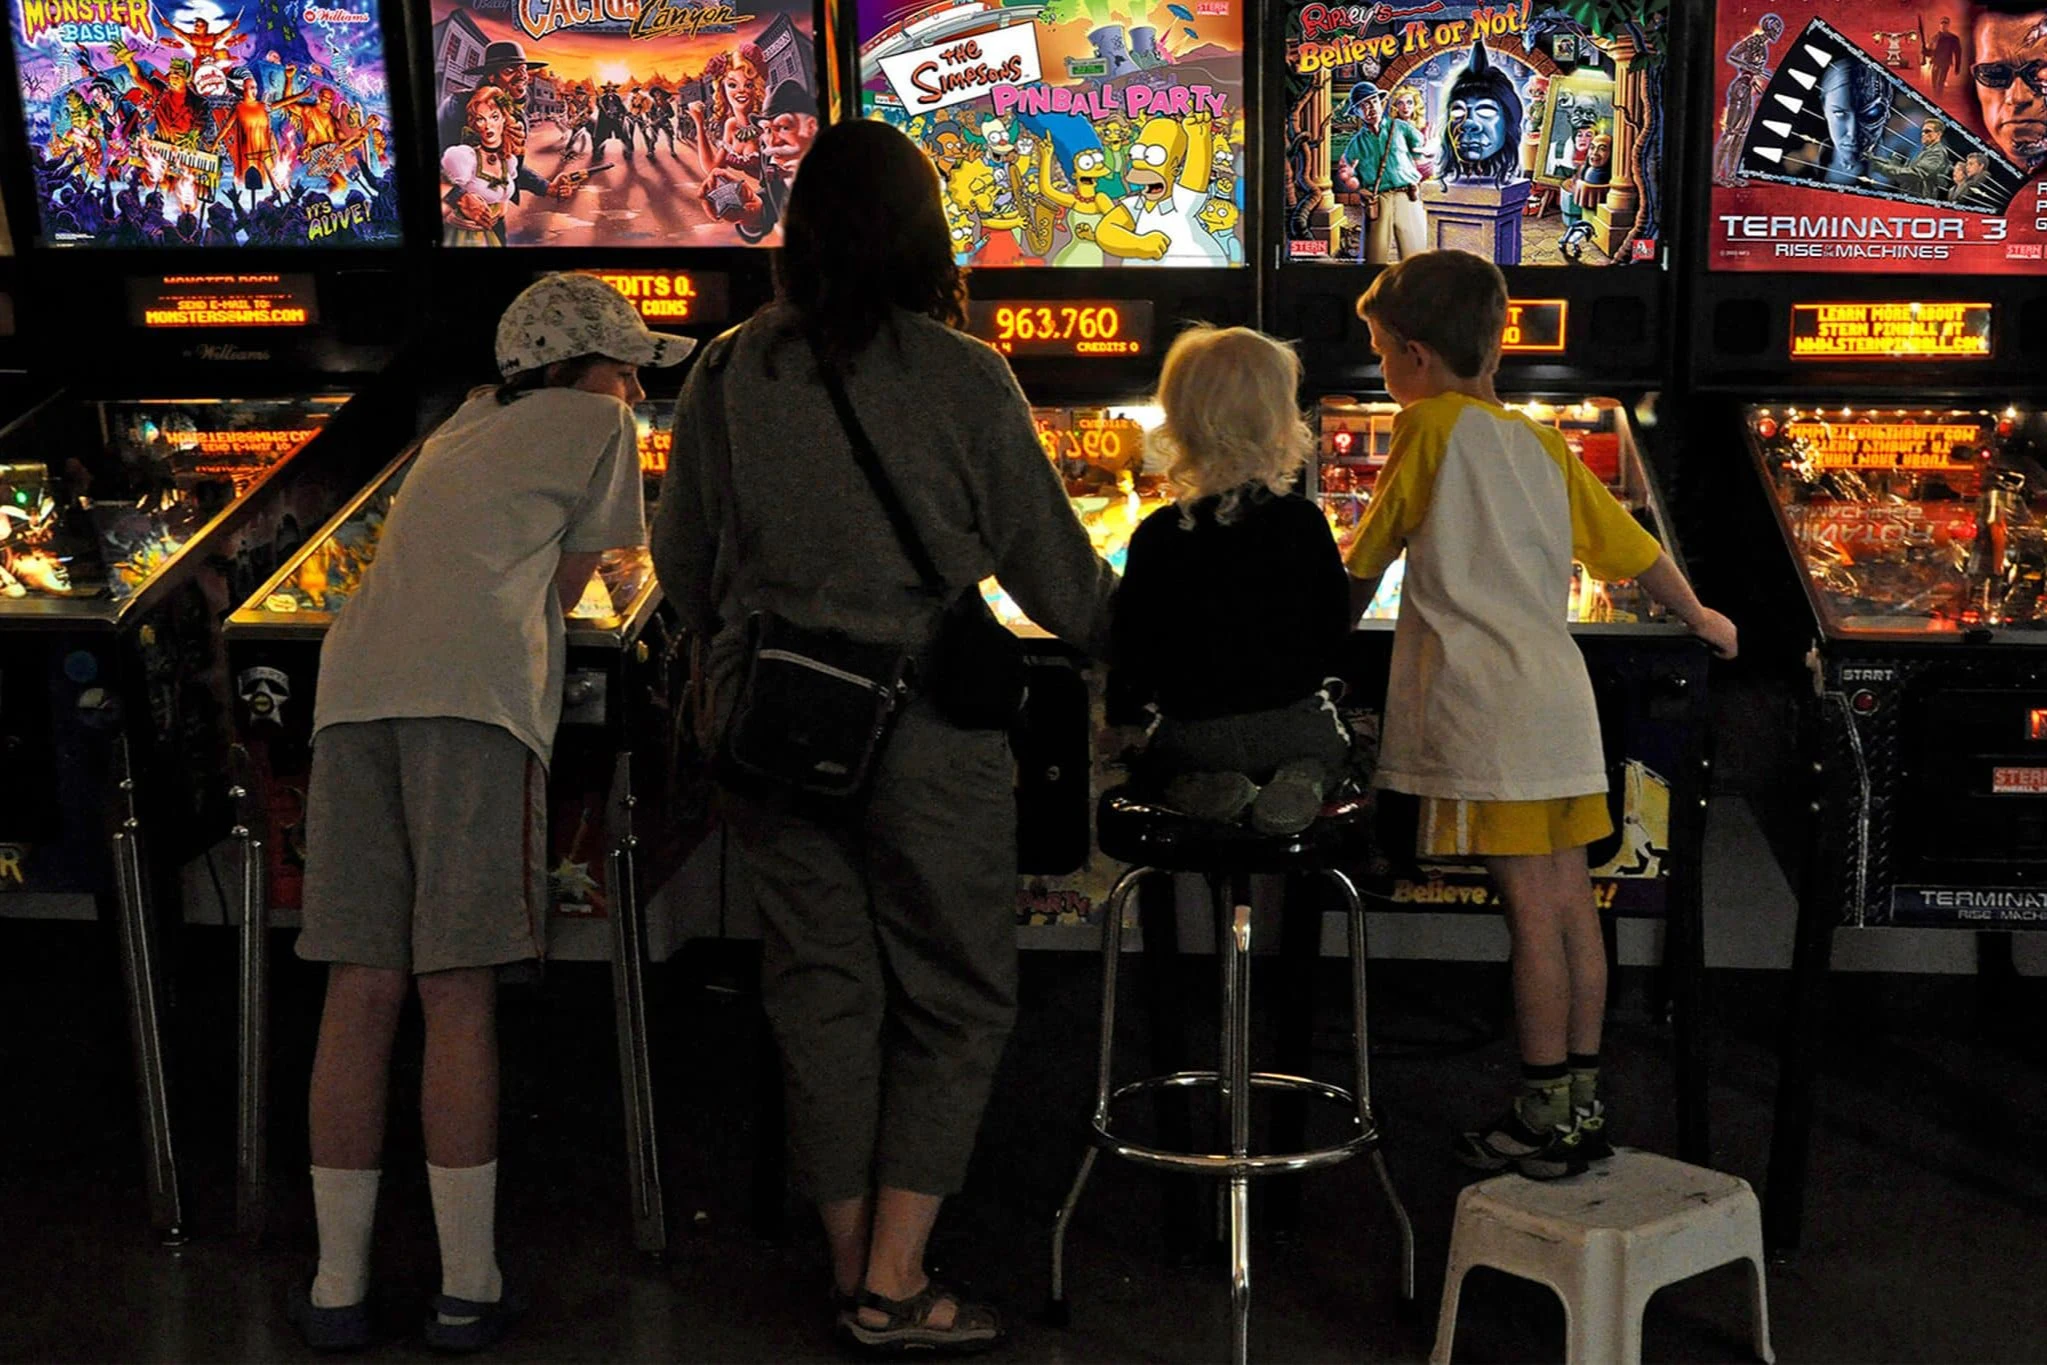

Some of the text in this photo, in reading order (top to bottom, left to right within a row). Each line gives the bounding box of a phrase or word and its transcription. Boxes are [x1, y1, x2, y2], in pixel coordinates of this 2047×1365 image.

[22, 0, 154, 42] MONSTER
[60, 22, 121, 42] BASH
[1298, 0, 1531, 74] Believe It or Not!
[991, 83, 1228, 120] PINBALL PARTY
[308, 200, 372, 241] ALIVE!
[1719, 215, 2007, 240] TERMINATOR 3
[1290, 240, 1328, 252] STERN
[1775, 243, 1823, 257] RISE
[1835, 245, 1950, 259] MACHINES
[2006, 244, 2041, 255] STERN
[177, 300, 207, 310] SEND
[209, 300, 252, 310] E-MAIL
[641, 299, 688, 316] COINS
[1816, 307, 1966, 321] LEARN MORE ABOUT
[1817, 322, 1869, 336] STERN
[1872, 322, 1939, 336] PINBALL
[1076, 342, 1127, 352] CREDITS
[1843, 669, 1893, 681] START
[1391, 879, 1489, 904] Believe
